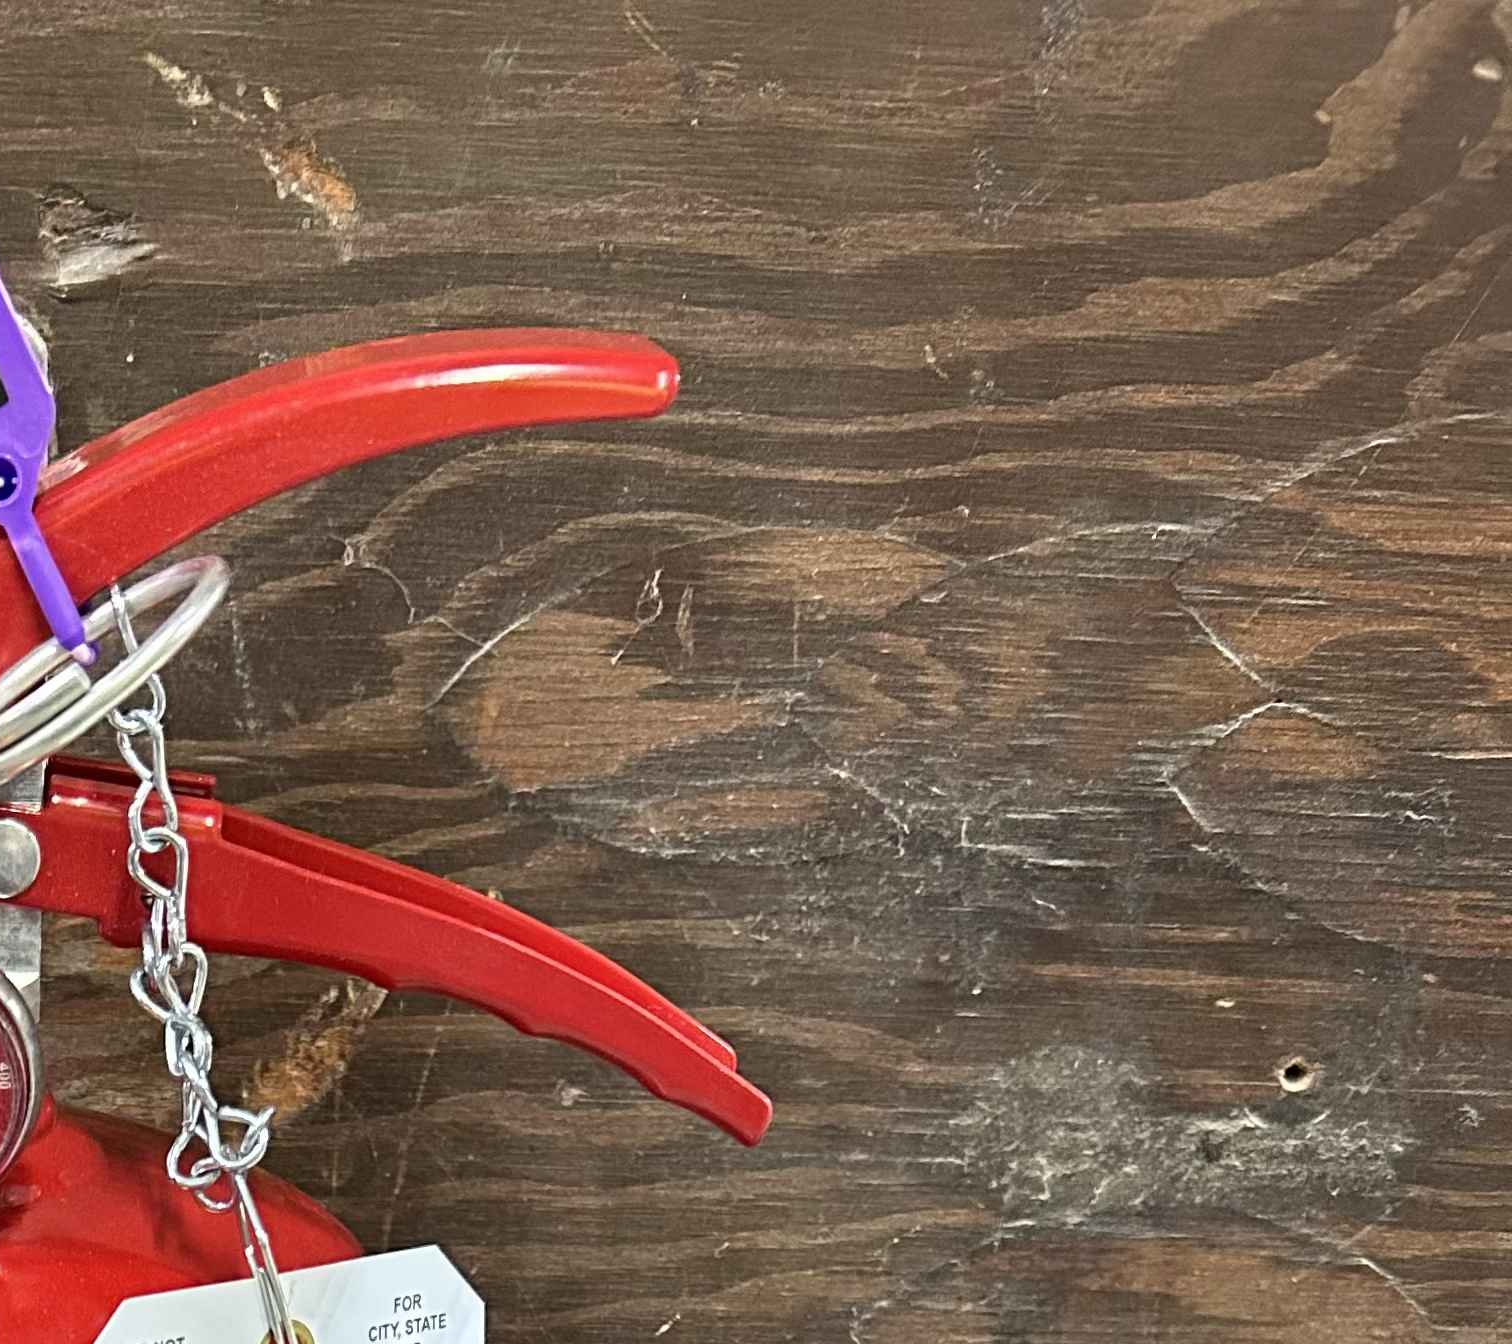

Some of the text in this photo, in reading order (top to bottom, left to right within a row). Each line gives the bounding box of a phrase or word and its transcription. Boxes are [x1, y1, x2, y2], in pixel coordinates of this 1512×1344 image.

[394, 1293, 422, 1313] FOR
[369, 1313, 447, 1342] CITY, STATE
